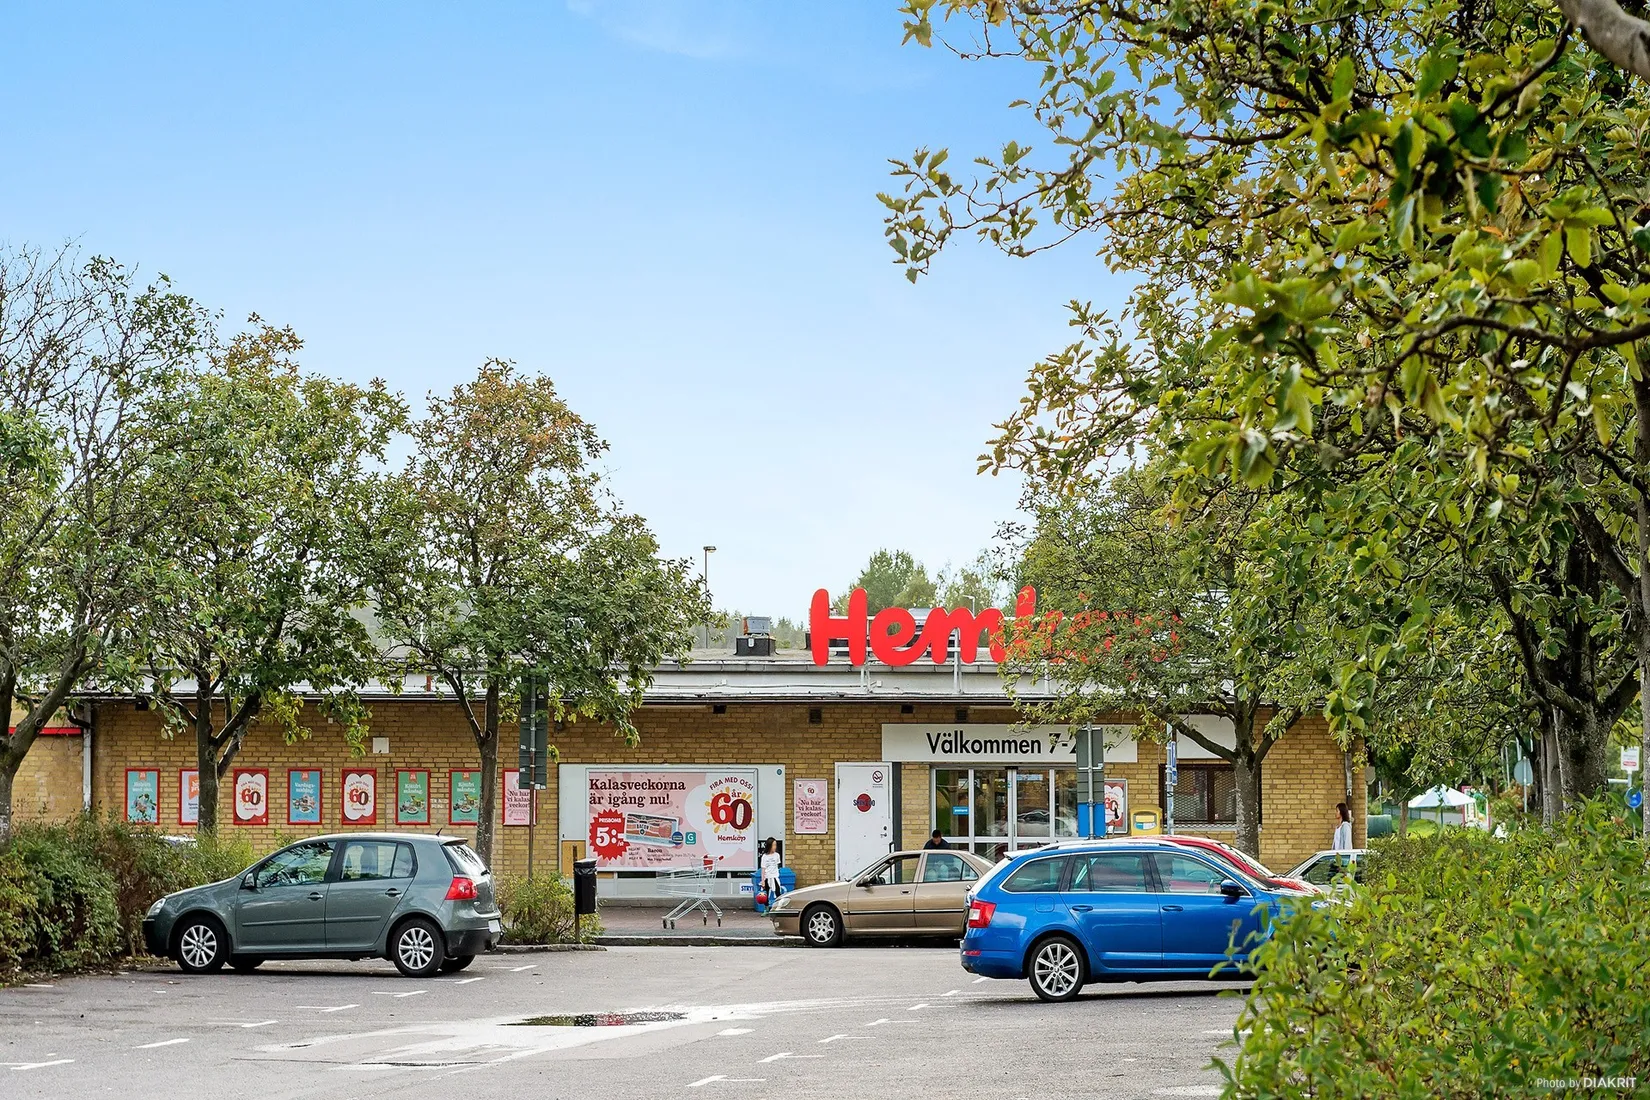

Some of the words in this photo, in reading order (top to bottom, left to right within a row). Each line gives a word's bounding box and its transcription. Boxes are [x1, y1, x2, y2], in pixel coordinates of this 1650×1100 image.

[926, 730, 1041, 754] Välkommen
[589, 778, 686, 790] Kalasveckorna
[709, 779, 723, 791] FIRA
[724, 776, 738, 784] MED
[740, 778, 754, 791] OSS!
[242, 788, 261, 805] 60
[348, 788, 368, 805] 60
[589, 792, 604, 805] är
[608, 791, 646, 808] igång
[650, 793, 670, 805] nu!
[731, 789, 742, 798] år
[710, 792, 752, 830] 60
[1104, 797, 1118, 812] 60
